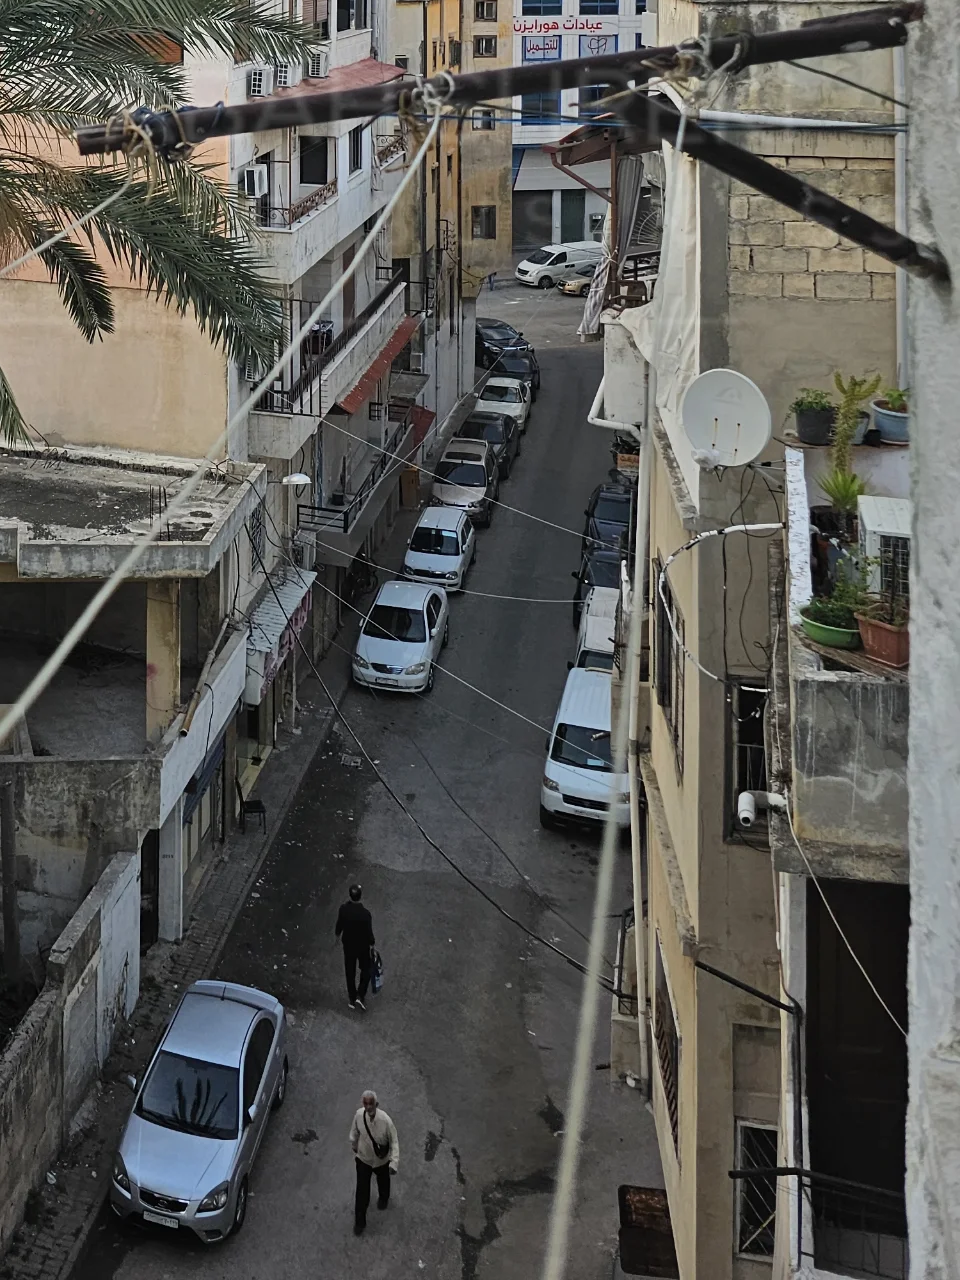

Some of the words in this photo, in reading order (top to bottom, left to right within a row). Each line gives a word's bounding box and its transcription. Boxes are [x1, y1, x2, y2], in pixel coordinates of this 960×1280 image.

[513, 19, 560, 34] هورايزن
[562, 18, 603, 34] عيادات
[526, 38, 558, 54] للتجميل
